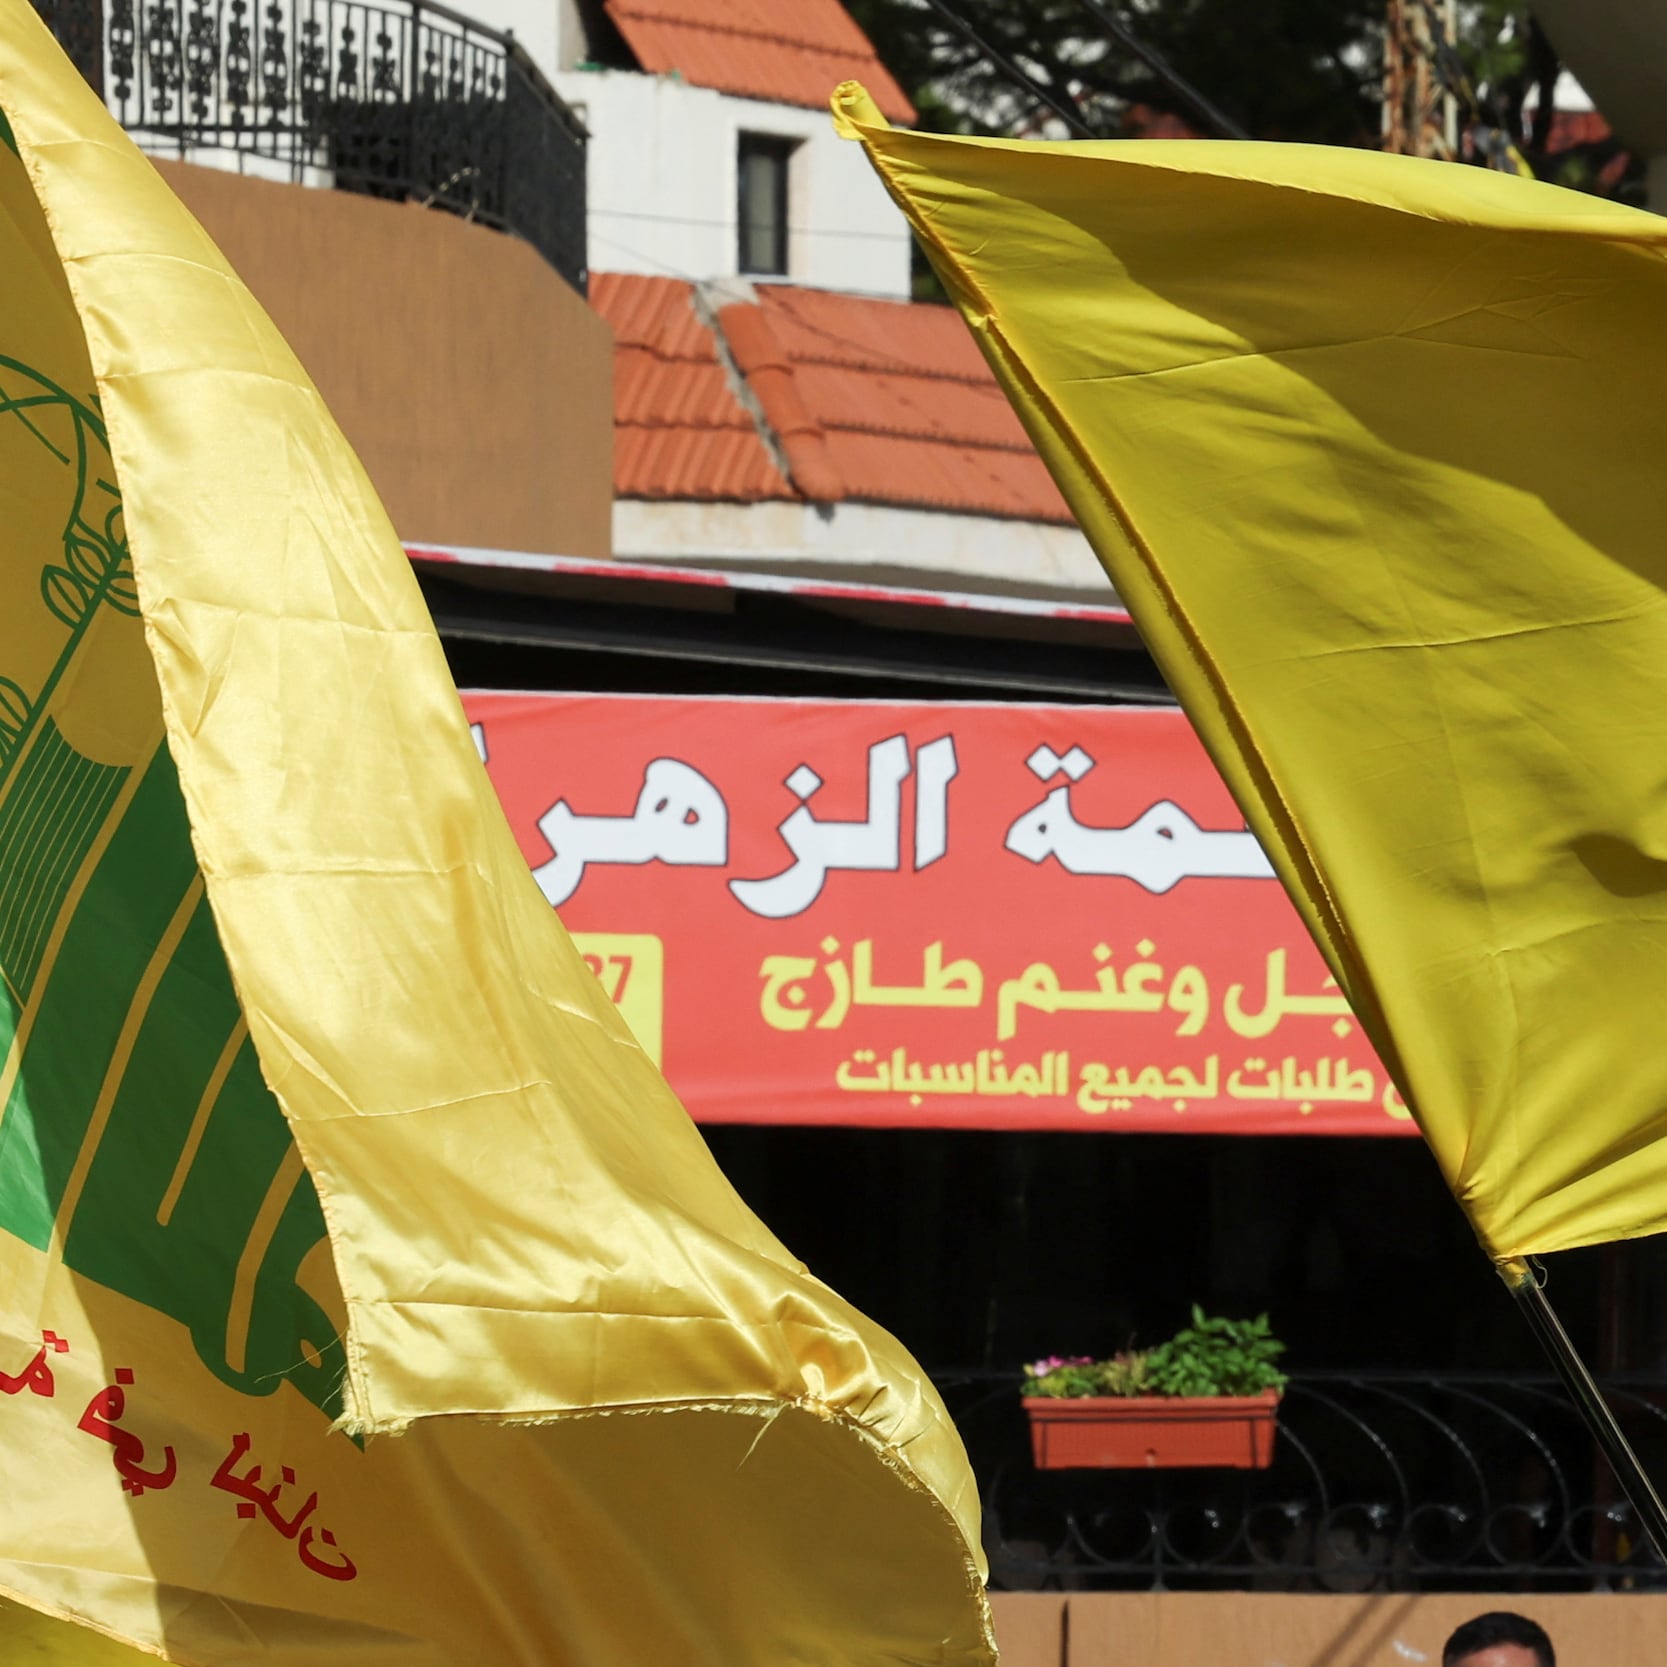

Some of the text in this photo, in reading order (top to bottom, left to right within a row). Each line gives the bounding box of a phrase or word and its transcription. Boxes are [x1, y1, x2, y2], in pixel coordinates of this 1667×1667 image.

[757, 935, 984, 1031] طازج
[996, 937, 1209, 1041] وغنم
[834, 1047, 1068, 1107] المناسبات
[1076, 1055, 1218, 1116] لجميع
[1226, 1057, 1375, 1115] طلبات
